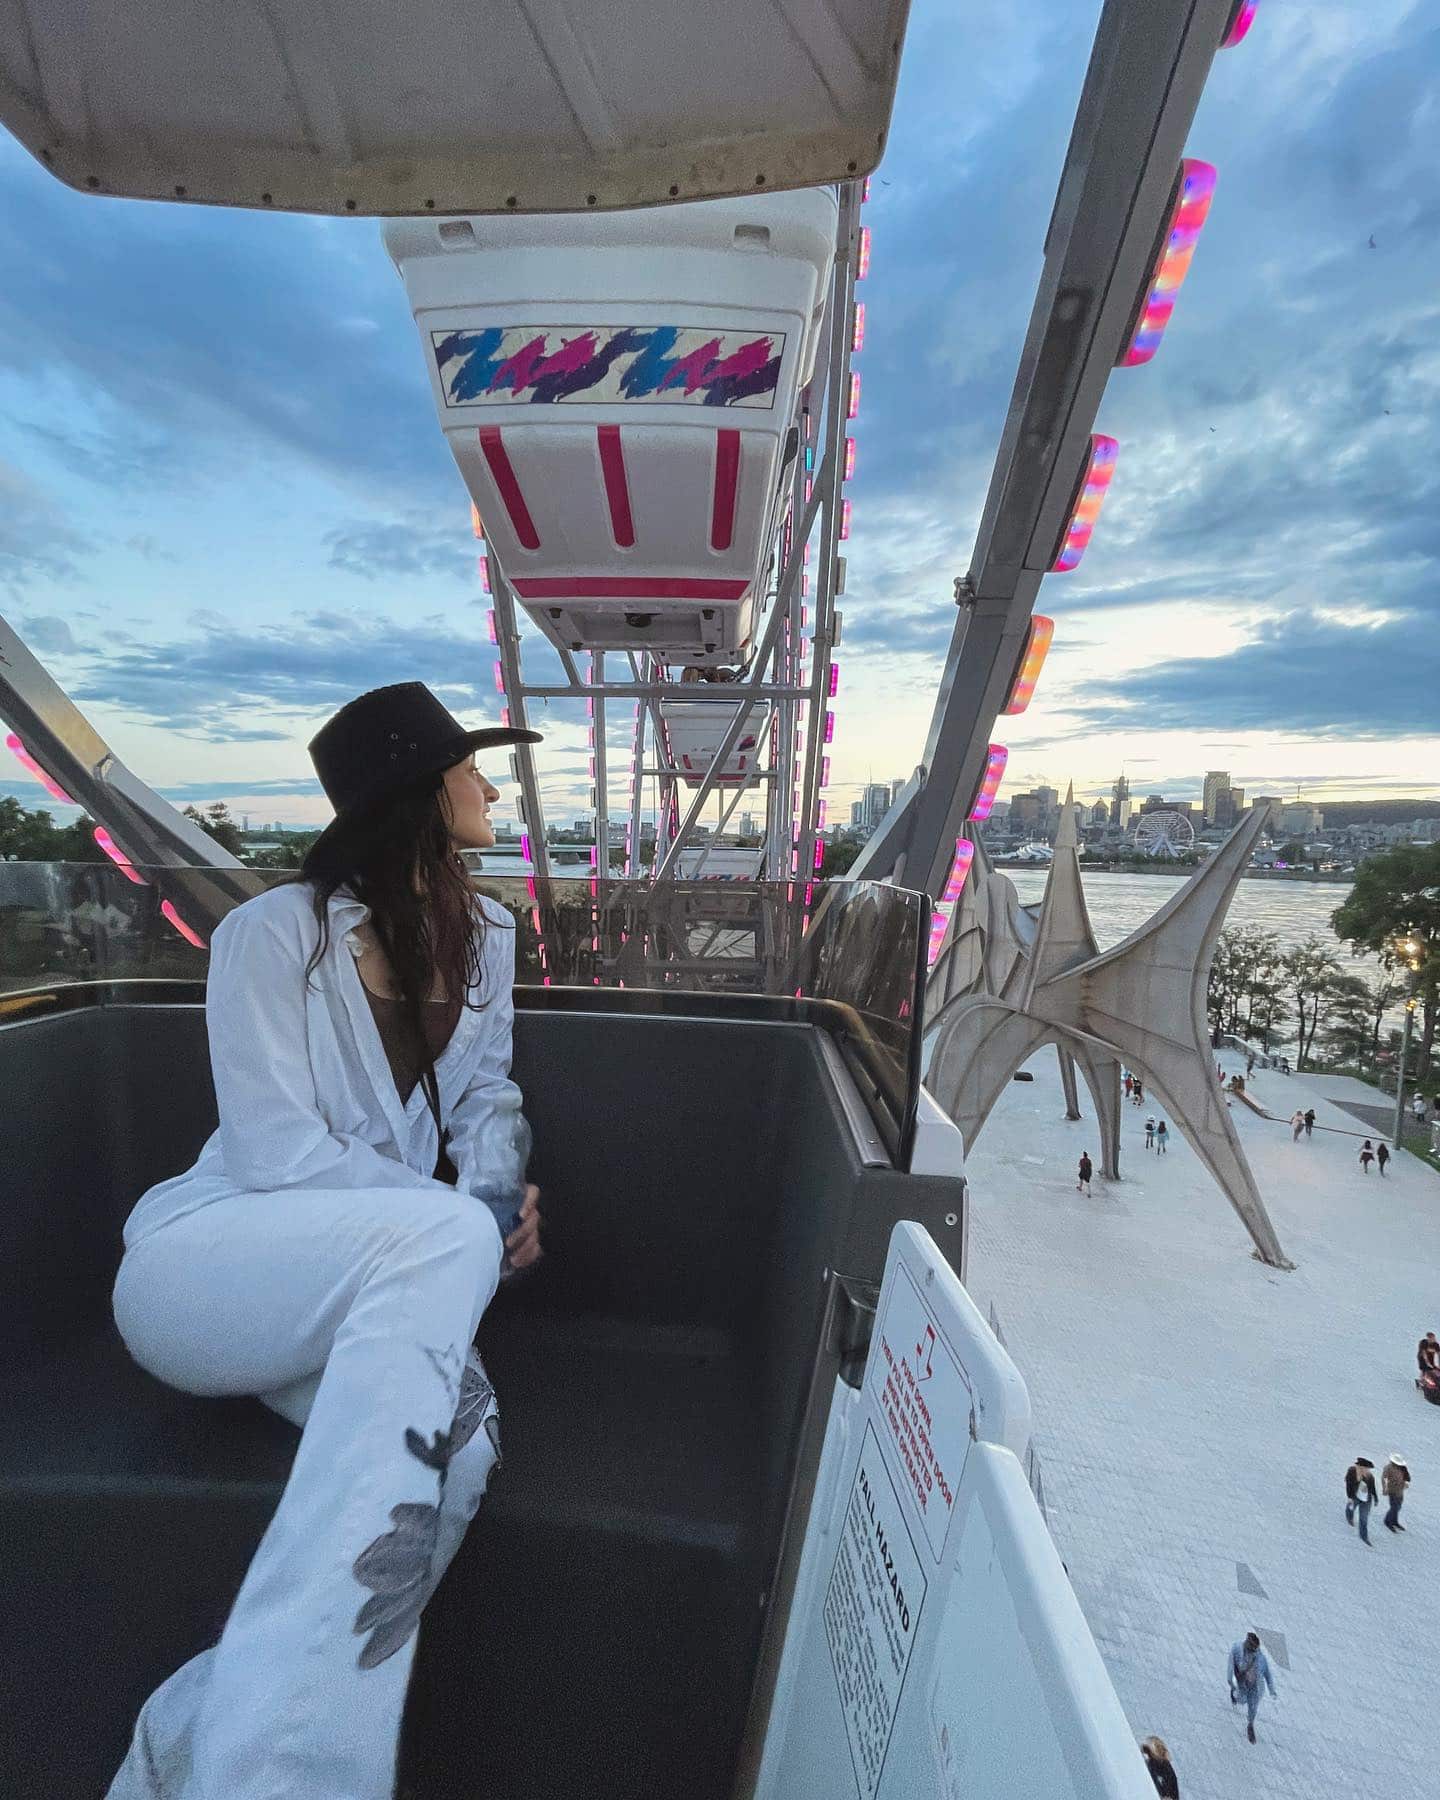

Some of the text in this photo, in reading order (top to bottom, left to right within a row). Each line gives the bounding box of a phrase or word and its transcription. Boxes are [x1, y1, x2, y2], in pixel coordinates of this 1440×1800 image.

[893, 1362, 905, 1395] PULL
[904, 1390, 911, 1410] IN
[911, 1404, 919, 1427] TO
[918, 1424, 934, 1465] OPEN
[933, 1461, 952, 1511] DOOR
[899, 1407, 932, 1492] INSTRUCTED
[859, 1467, 875, 1526] FALL
[876, 1521, 909, 1632] HAZARD
